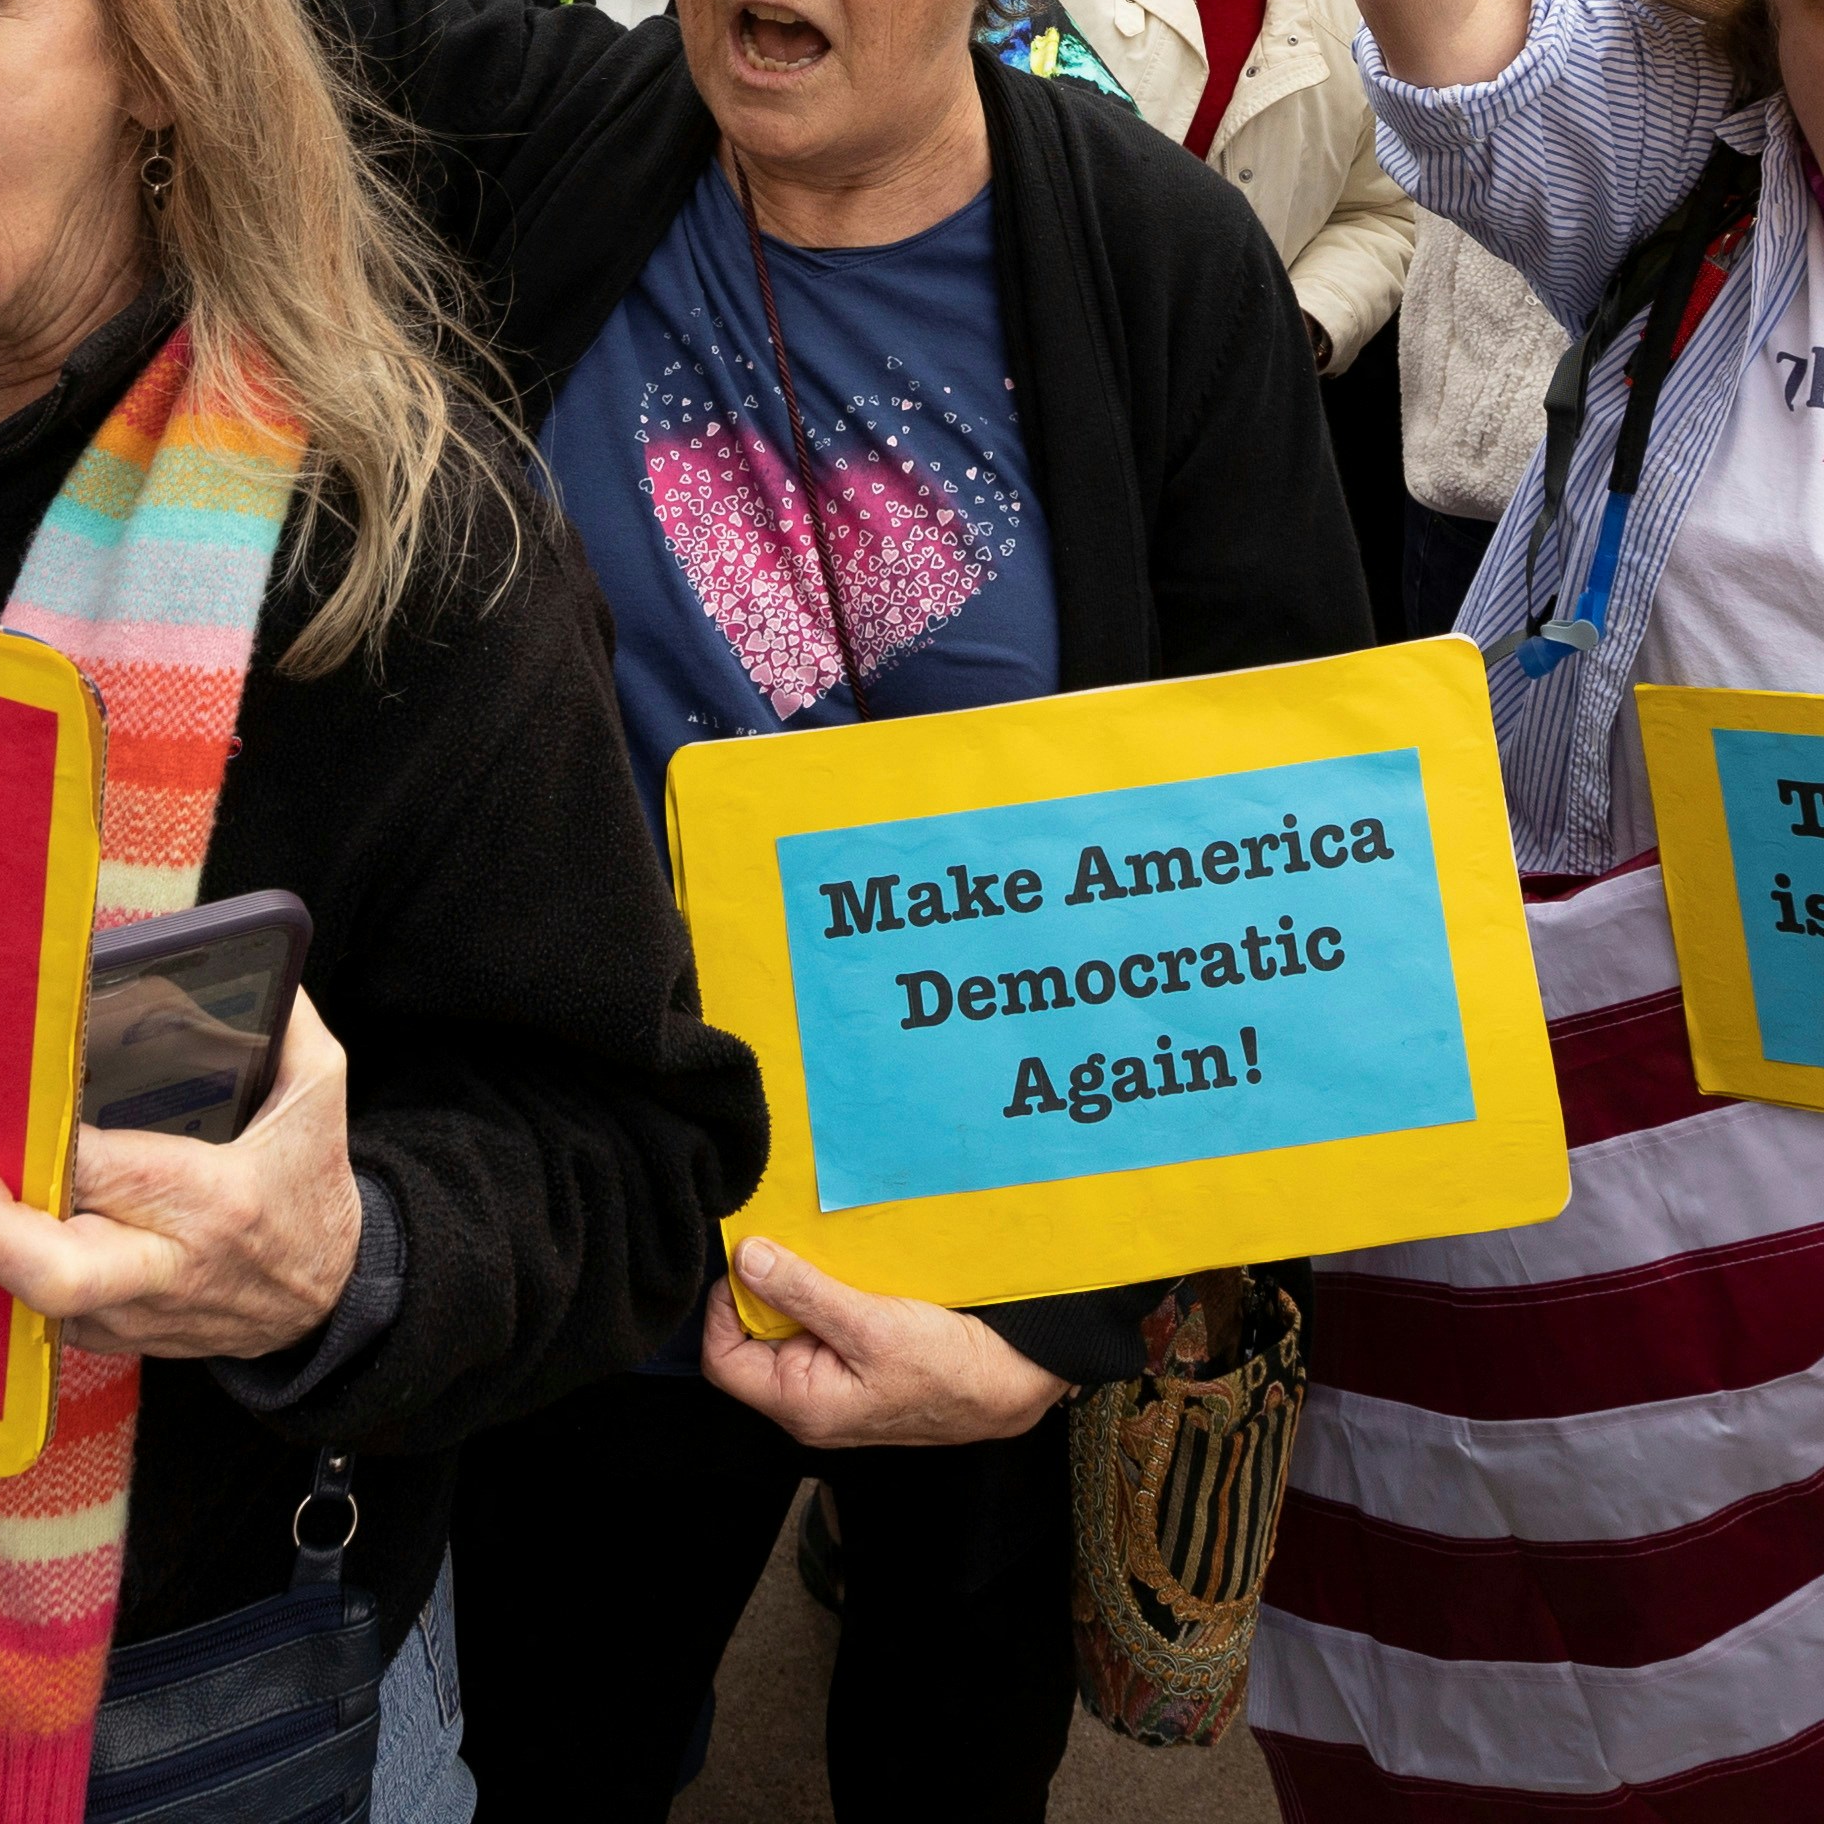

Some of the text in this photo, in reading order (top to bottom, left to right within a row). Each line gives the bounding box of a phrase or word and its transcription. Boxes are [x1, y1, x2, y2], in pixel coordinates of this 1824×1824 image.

[819, 813, 1395, 940] Make America
[894, 914, 1347, 1031] Democratic
[1002, 1025, 1263, 1124] Again!
